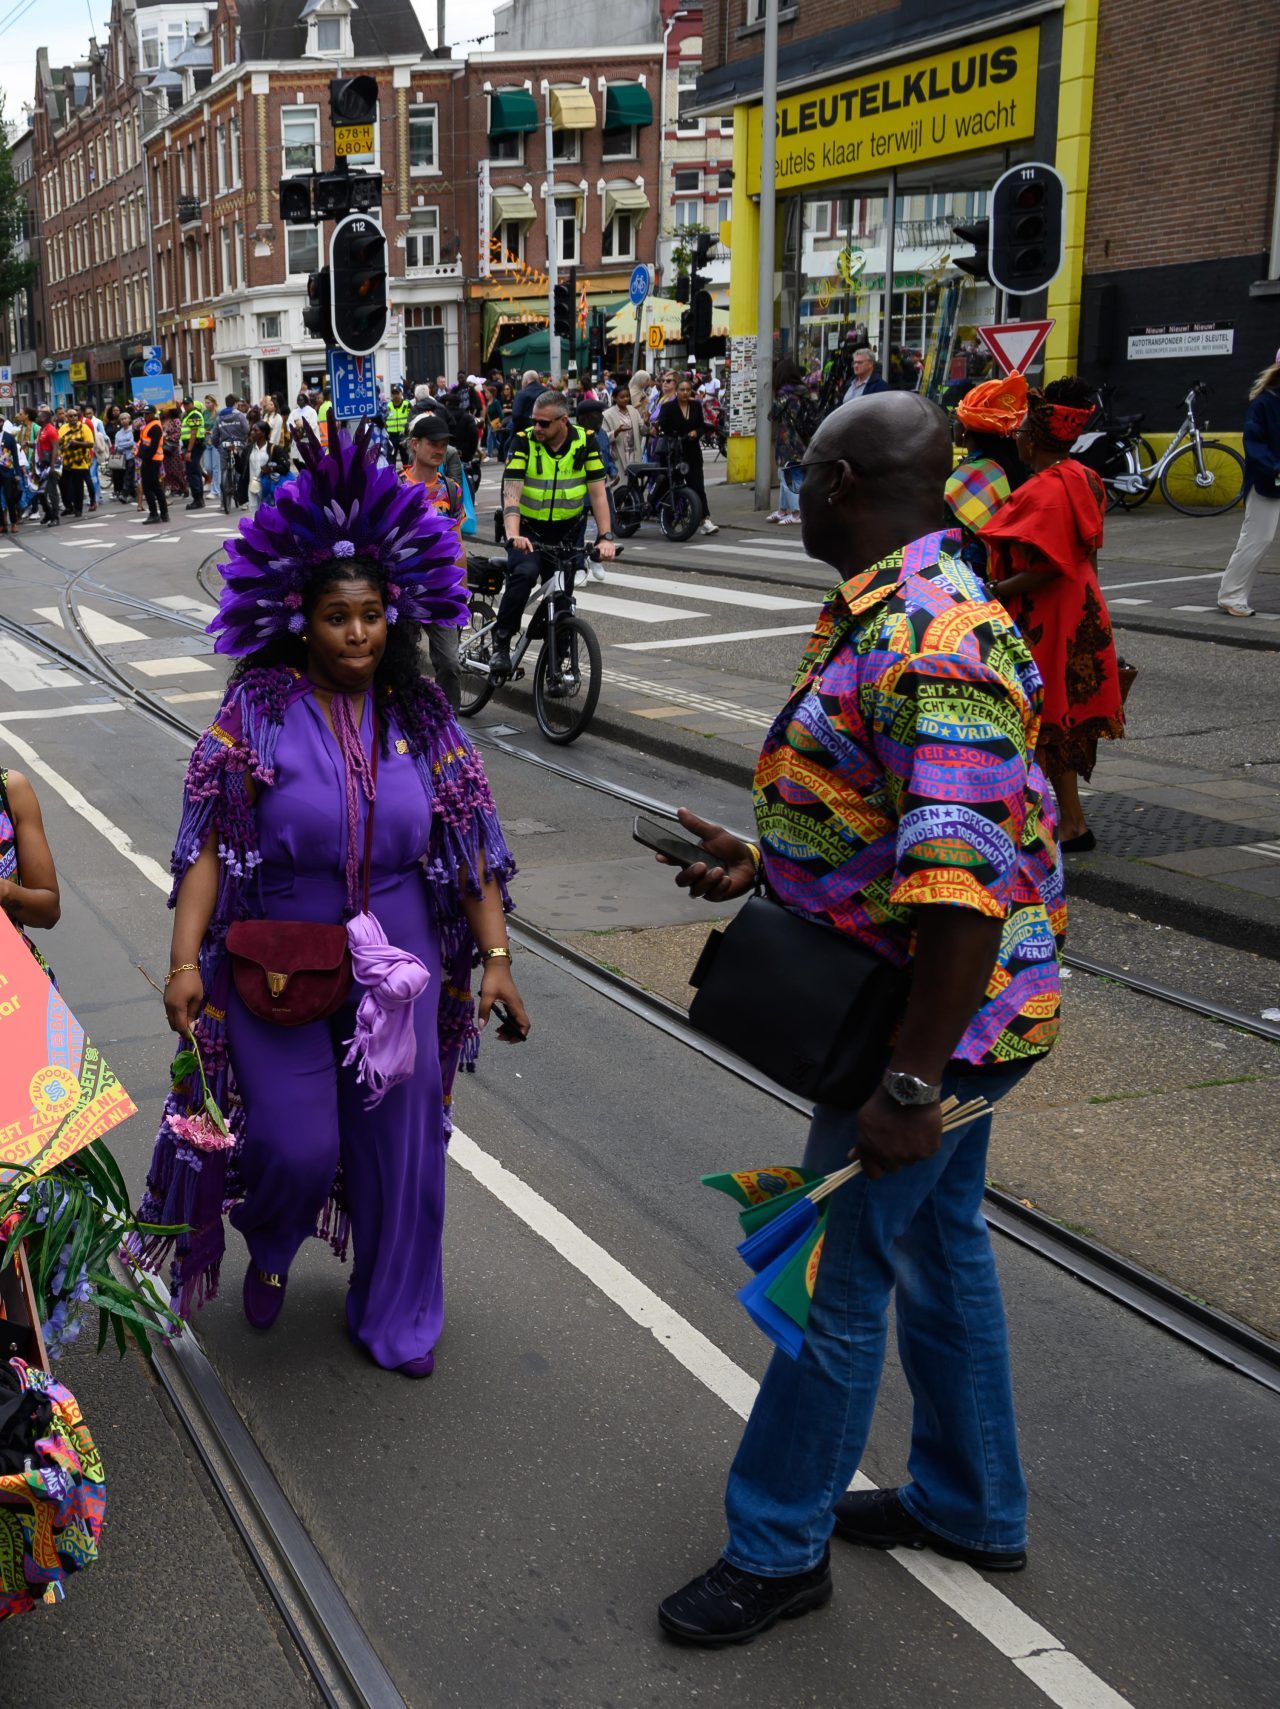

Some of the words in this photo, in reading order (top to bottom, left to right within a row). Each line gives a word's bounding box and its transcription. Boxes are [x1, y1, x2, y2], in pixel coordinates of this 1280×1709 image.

[338, 127, 370, 140] 678-H
[760, 150, 816, 178] eutels
[823, 140, 864, 168] klaar
[871, 119, 922, 158] terwijl
[931, 114, 947, 144] U
[955, 99, 1017, 139] wacht
[337, 141, 373, 154] 680-V
[1020, 169, 1035, 180] 111
[352, 221, 365, 232] 112
[1145, 326, 1167, 334] Nieuw!
[1168, 324, 1190, 333] Nieuw!
[1193, 322, 1216, 331] Nieuw!
[1131, 336, 1183, 347] AUTOTRANSPONDER
[1205, 333, 1229, 343] SLEUTEL
[337, 404, 357, 416] LET
[358, 403, 374, 413] OP
[917, 684, 945, 698] CHT
[32, 1068, 73, 1101] ZUIDOOST
